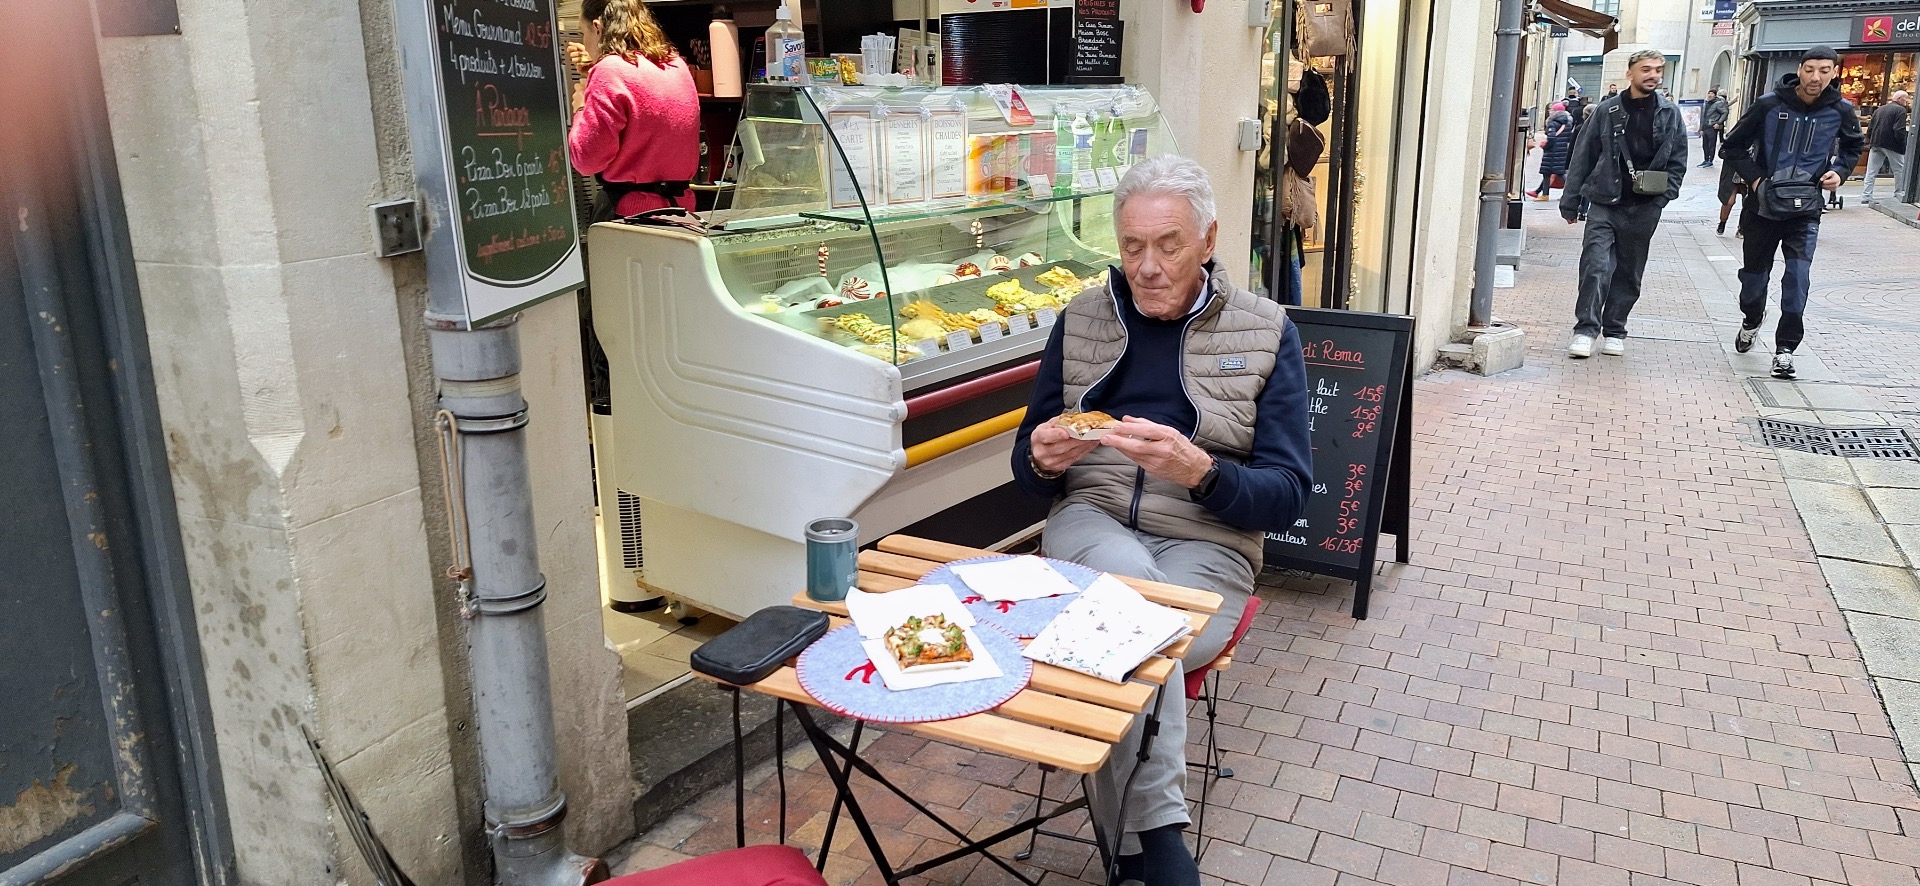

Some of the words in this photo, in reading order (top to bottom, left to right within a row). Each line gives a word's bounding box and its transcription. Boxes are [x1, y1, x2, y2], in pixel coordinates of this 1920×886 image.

[443, 3, 475, 37] Menu
[473, 8, 524, 45] Gourmand
[450, 40, 458, 70] 4
[459, 47, 498, 85] produits
[888, 119, 918, 129] DESSERTS
[934, 119, 962, 129] BOISSONS
[840, 134, 864, 144] CARTE
[935, 131, 962, 141] CHAUDES
[462, 146, 494, 182] Pizza
[516, 152, 522, 176] 6
[466, 186, 502, 219] Pizza
[1302, 342, 1318, 358] di
[1321, 339, 1365, 364] Roma
[1316, 377, 1340, 397] lait
[1307, 396, 1329, 415] the
[1347, 464, 1367, 481] 3€
[1344, 480, 1364, 498] 3€
[1340, 500, 1361, 517] 5€
[1336, 517, 1358, 535] 3€
